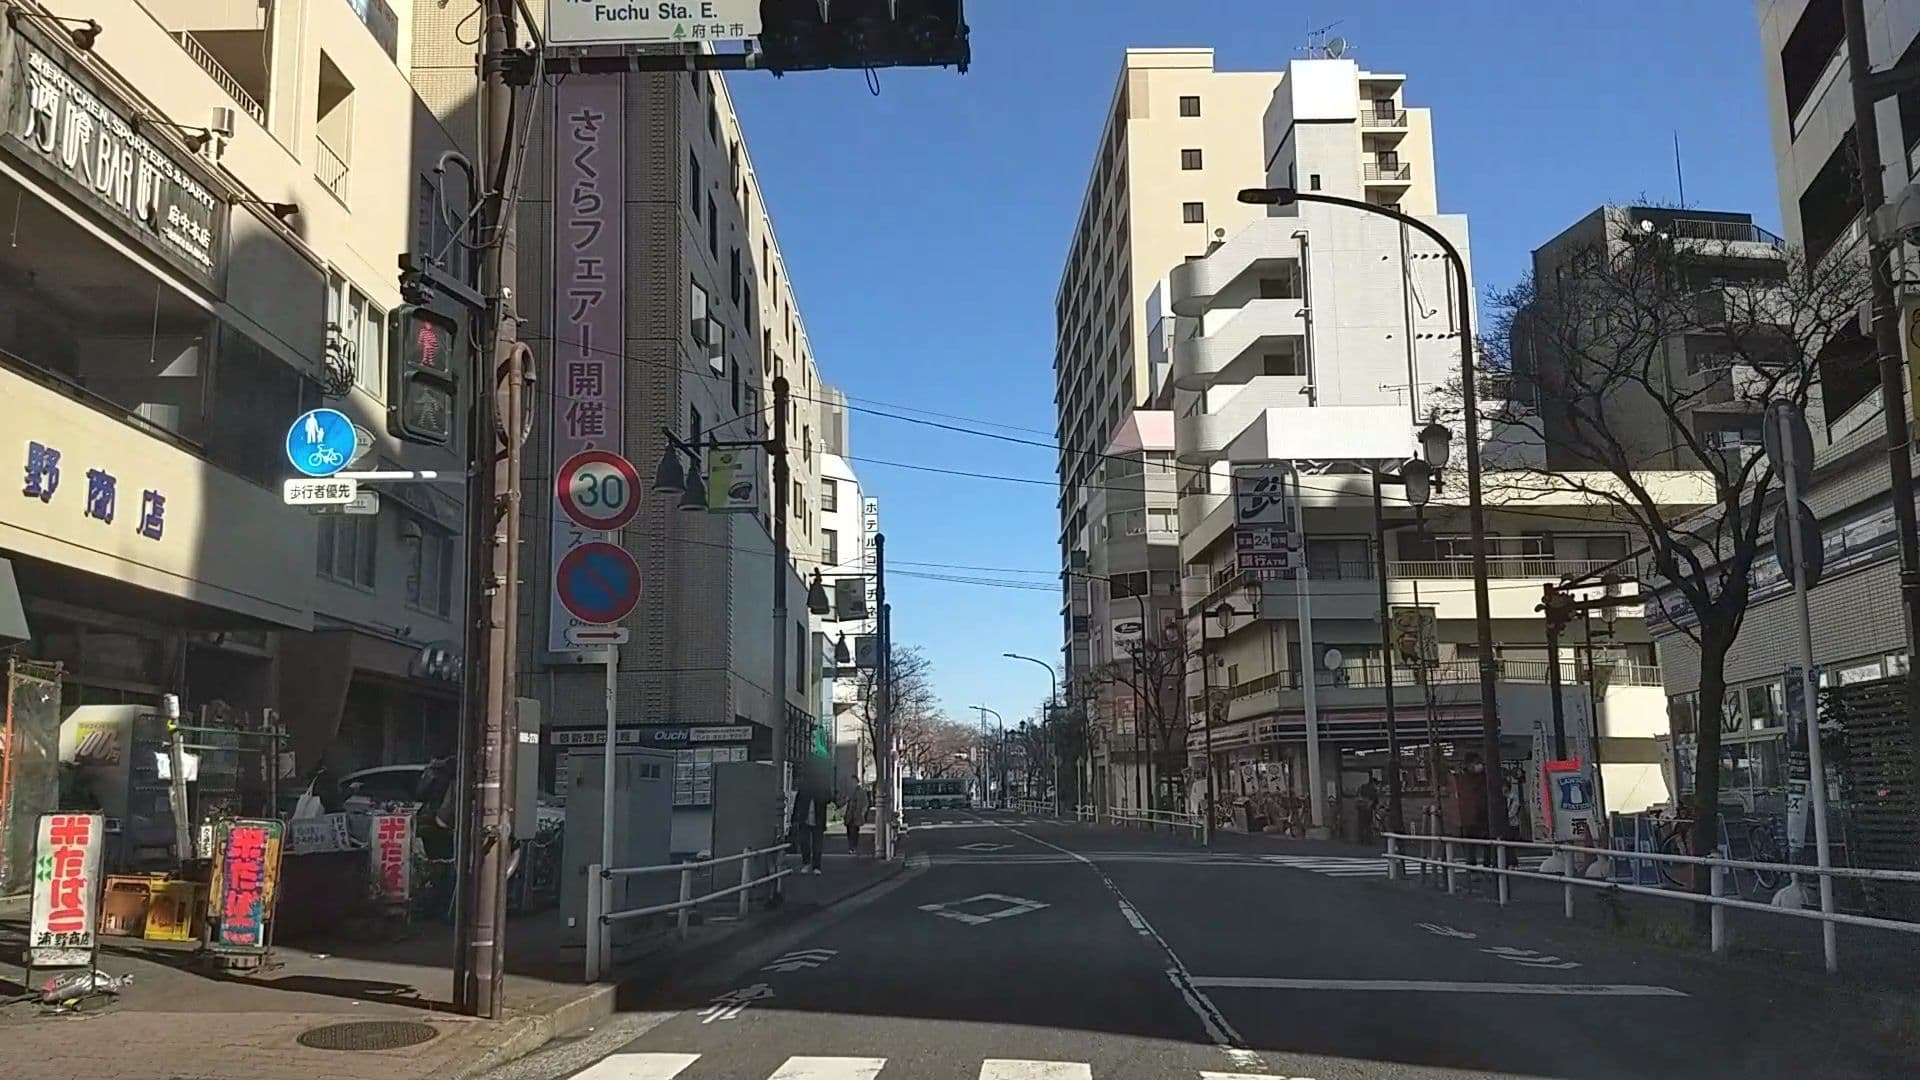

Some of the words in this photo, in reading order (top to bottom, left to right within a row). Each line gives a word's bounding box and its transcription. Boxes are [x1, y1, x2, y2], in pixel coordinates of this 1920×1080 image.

[595, 4, 649, 21] Fuchu
[658, 3, 692, 19] Sta.
[701, 2, 718, 18] E.
[691, 23, 744, 38] 府中市
[111, 119, 173, 178] SPORTER'S
[182, 175, 215, 211] PARTY
[167, 205, 211, 249] 府中本店
[566, 109, 605, 449] さくらフェアー開催
[22, 440, 166, 541] 野商店
[290, 484, 351, 500] 歩行者優先
[577, 473, 624, 509] 30
[654, 729, 689, 742] Ouchi
[47, 816, 91, 932] 米たばこ
[37, 932, 91, 947] 浦野商店
